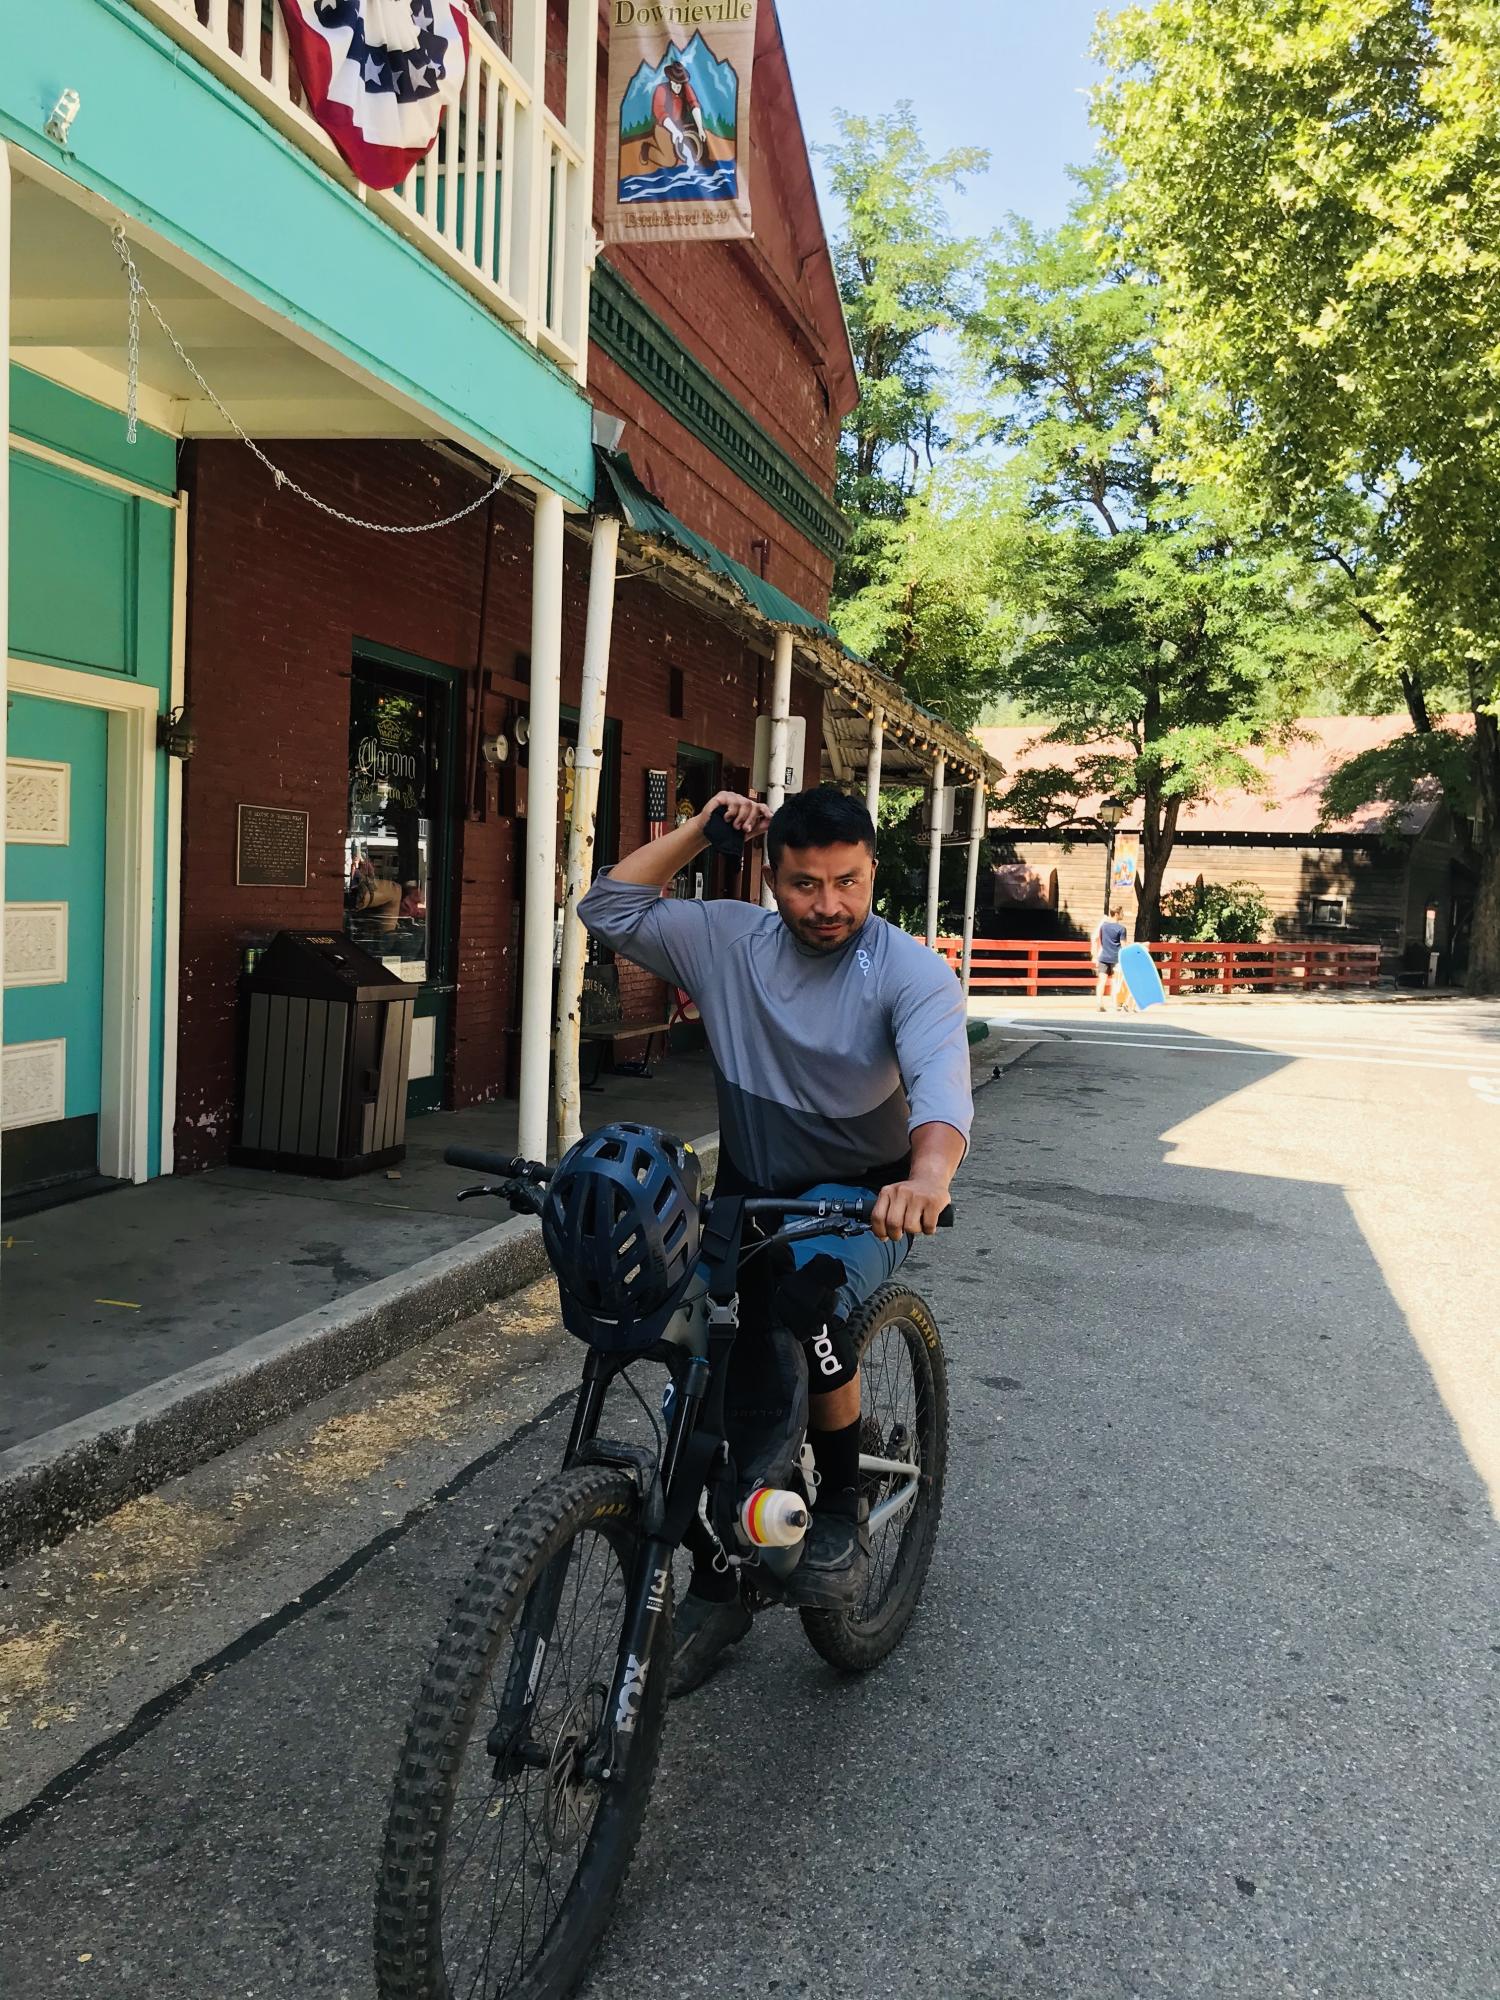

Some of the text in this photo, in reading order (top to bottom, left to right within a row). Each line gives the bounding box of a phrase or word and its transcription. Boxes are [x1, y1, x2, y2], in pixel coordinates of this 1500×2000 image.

[615, 0, 752, 26] Downieville
[359, 736, 416, 780] Corona
[909, 1304, 938, 1349] MAXXIS
[615, 1653, 650, 1733] FOX
